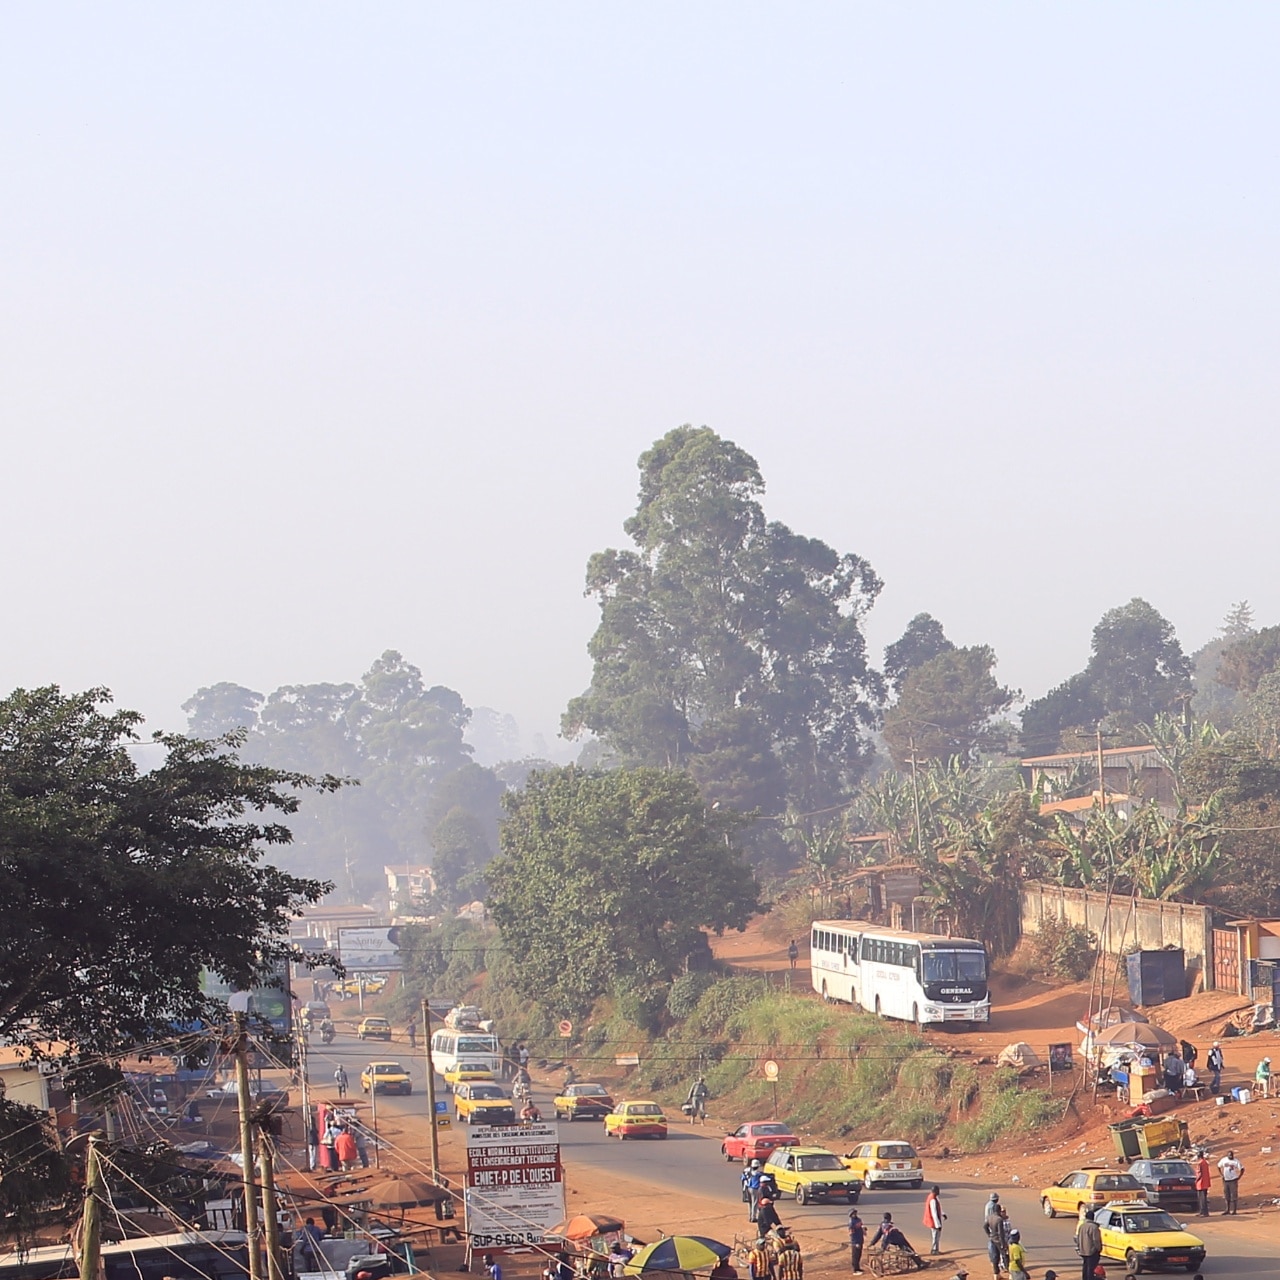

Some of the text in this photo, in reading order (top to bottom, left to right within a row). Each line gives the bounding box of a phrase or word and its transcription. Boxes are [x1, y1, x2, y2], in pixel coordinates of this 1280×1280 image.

[469, 1148, 486, 1157] ECOLE
[488, 1146, 514, 1156] NORMALE
[472, 1158, 479, 1167] DE
[526, 1154, 556, 1164] TECHNIQUE
[510, 1169, 520, 1183] DE
[522, 1168, 556, 1182] L'OUEST
[474, 1234, 492, 1247] SUP
